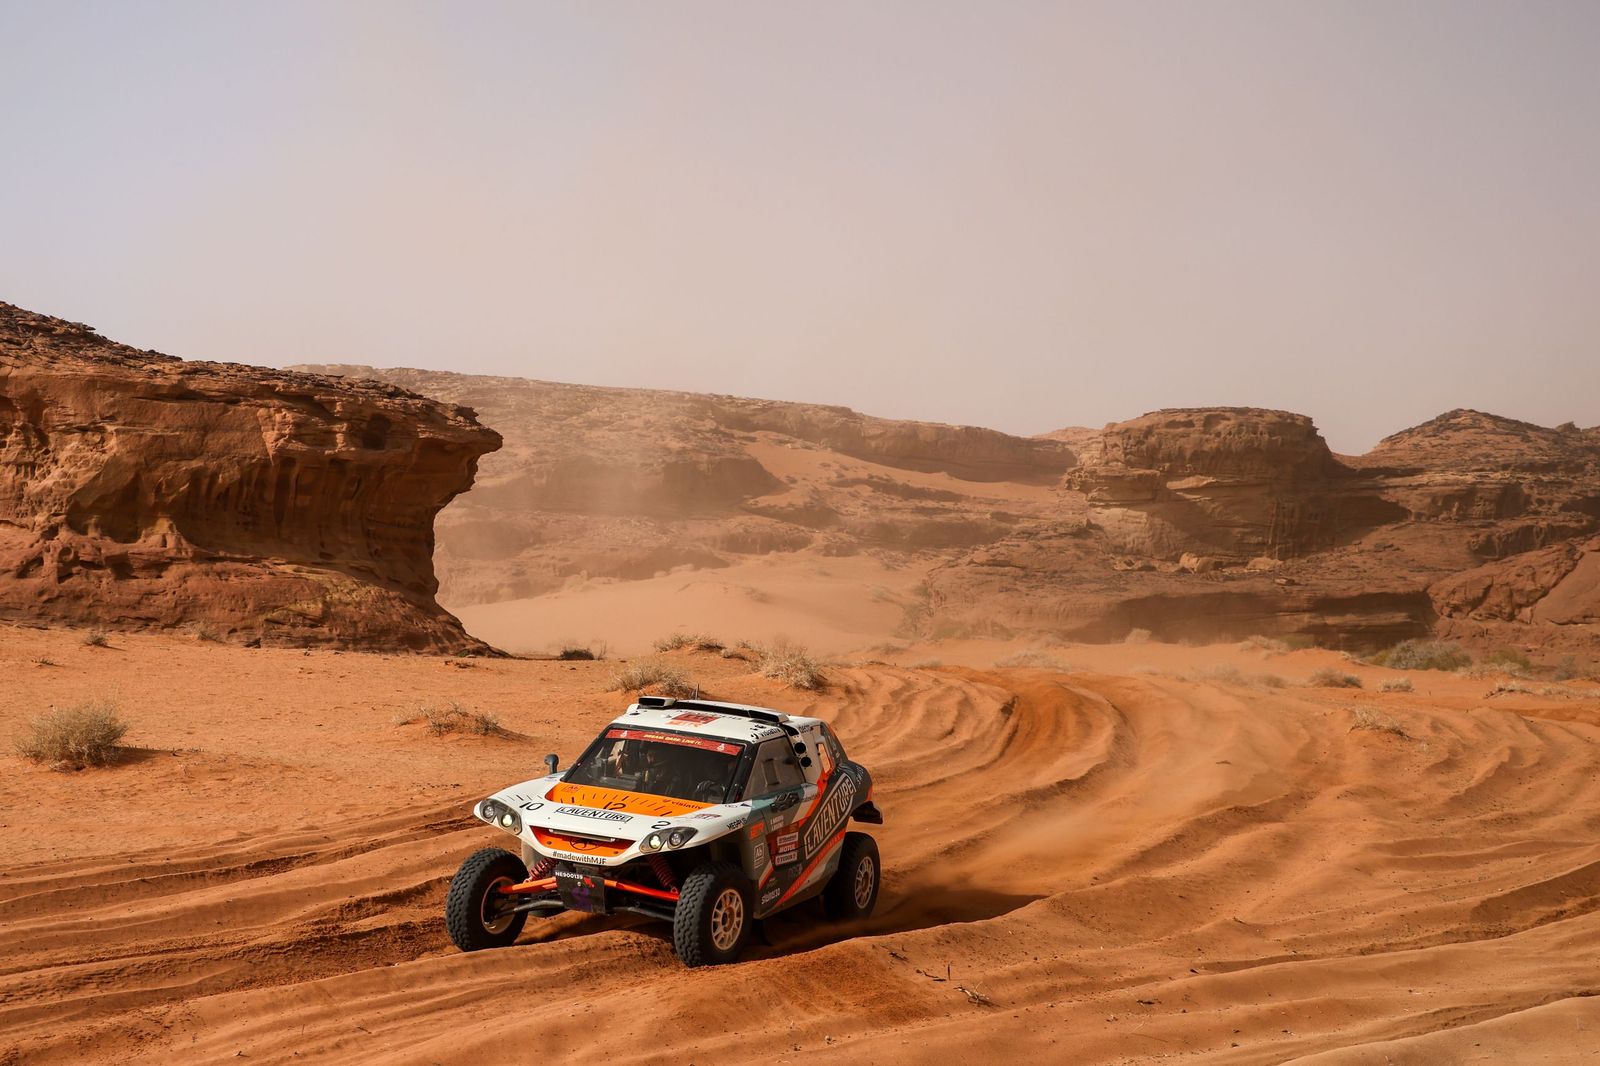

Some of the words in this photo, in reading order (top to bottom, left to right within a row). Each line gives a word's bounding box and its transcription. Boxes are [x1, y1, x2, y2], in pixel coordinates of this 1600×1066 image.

[519, 801, 544, 811] 10
[602, 801, 627, 811] 12
[651, 820, 671, 830] 2
[552, 851, 607, 865] #madewithMJF
